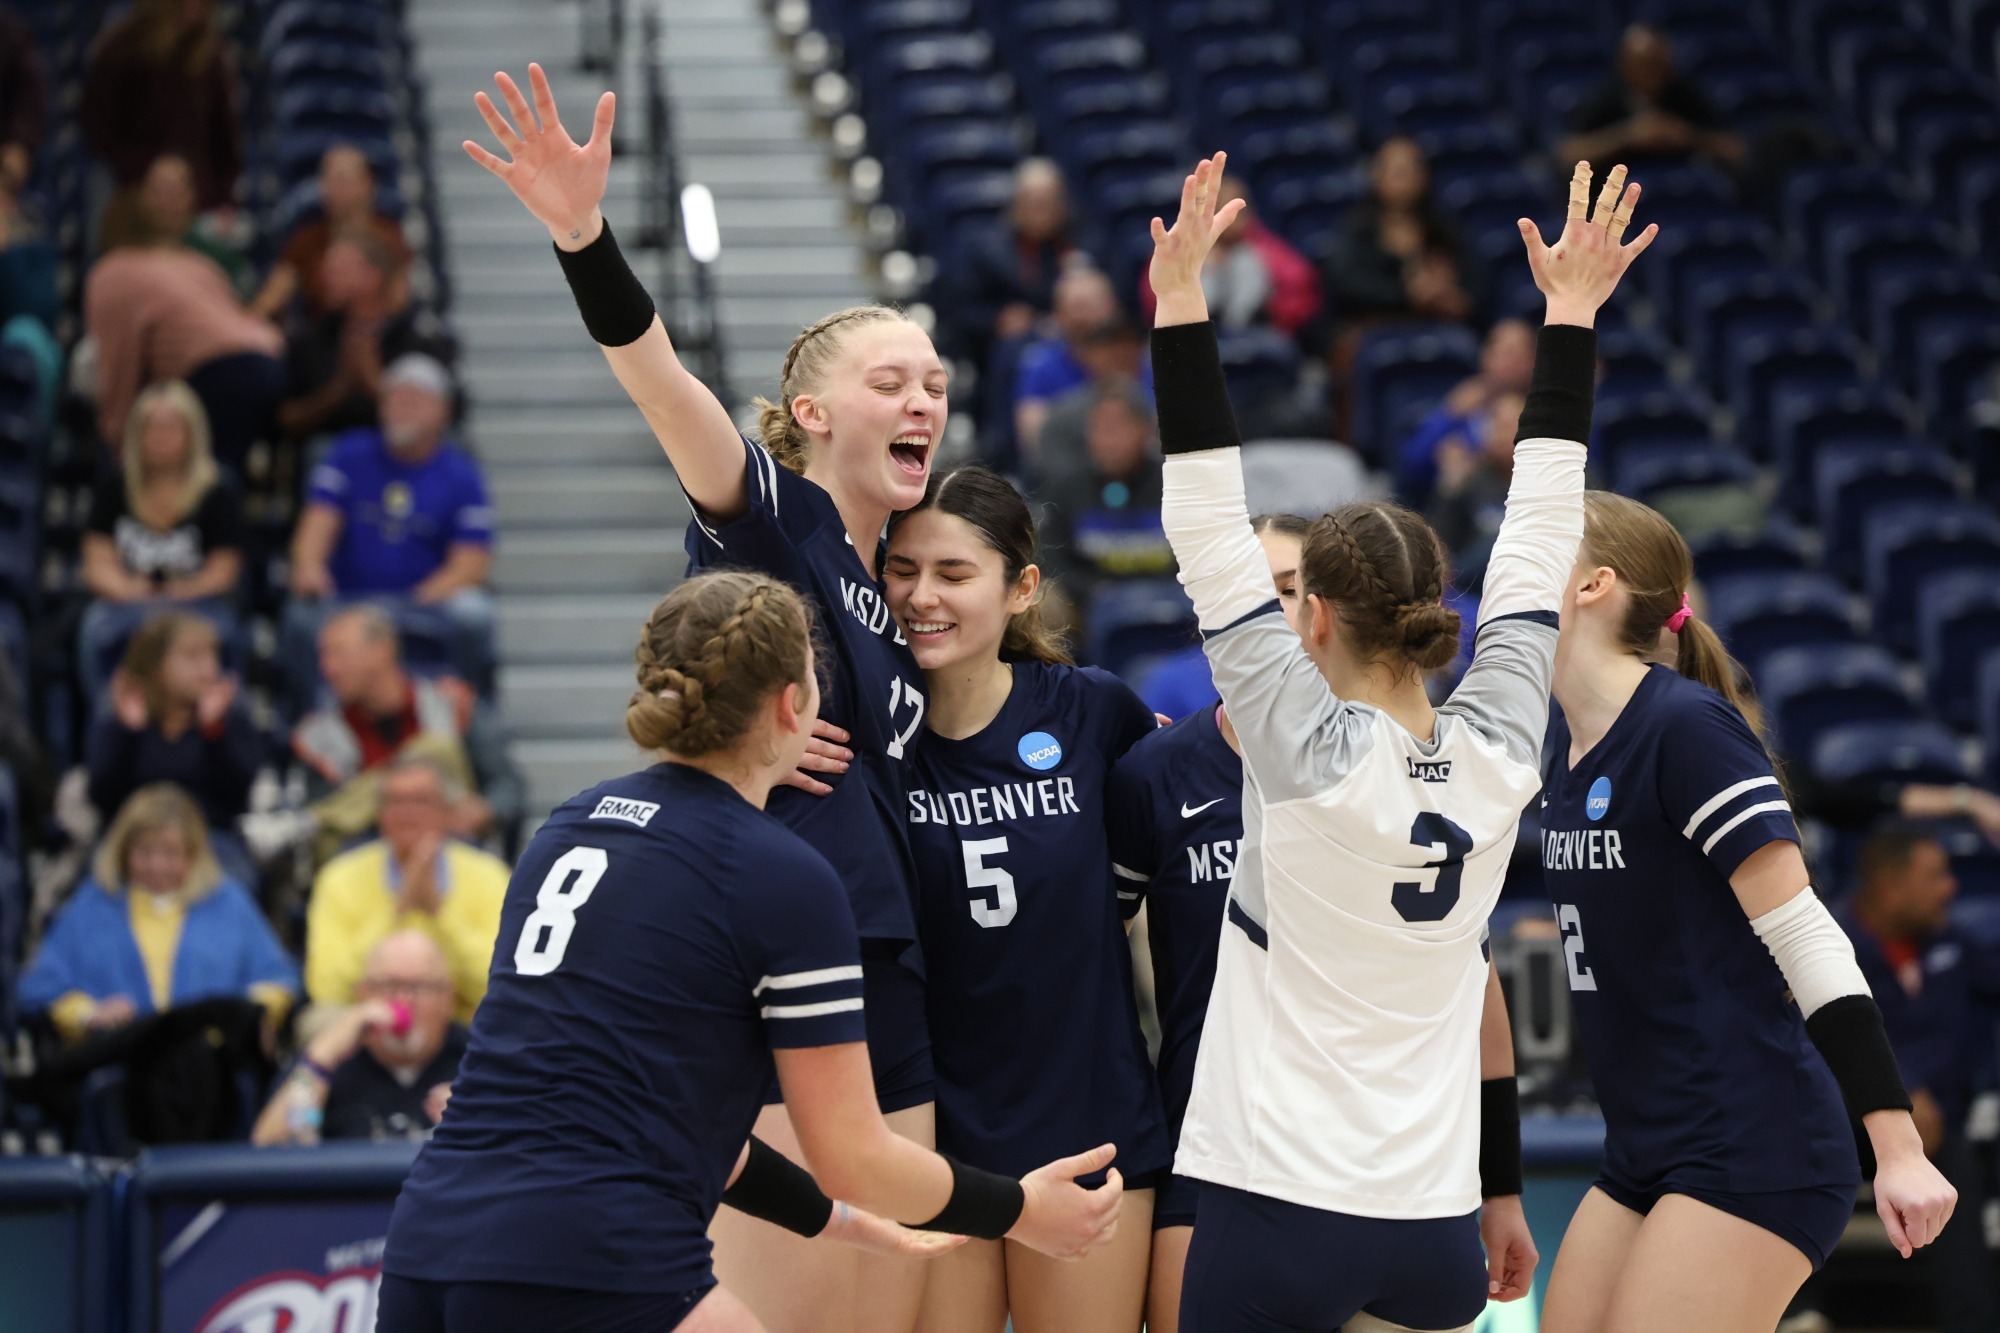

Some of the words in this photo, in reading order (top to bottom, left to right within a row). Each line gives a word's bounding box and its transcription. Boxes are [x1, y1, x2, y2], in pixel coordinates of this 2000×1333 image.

[840, 576, 889, 635] MSU
[887, 674, 925, 760] 17
[1027, 744, 1061, 764] NCAA
[1411, 763, 1451, 780] MAC
[597, 800, 653, 822] RMAC
[907, 789, 949, 825] SU
[948, 776, 1080, 826] DENVER
[1391, 811, 1474, 922] 3
[1546, 829, 1626, 870] DENVER
[513, 846, 608, 976] 8
[961, 836, 1018, 928] 5
[1553, 903, 1598, 991] 2
